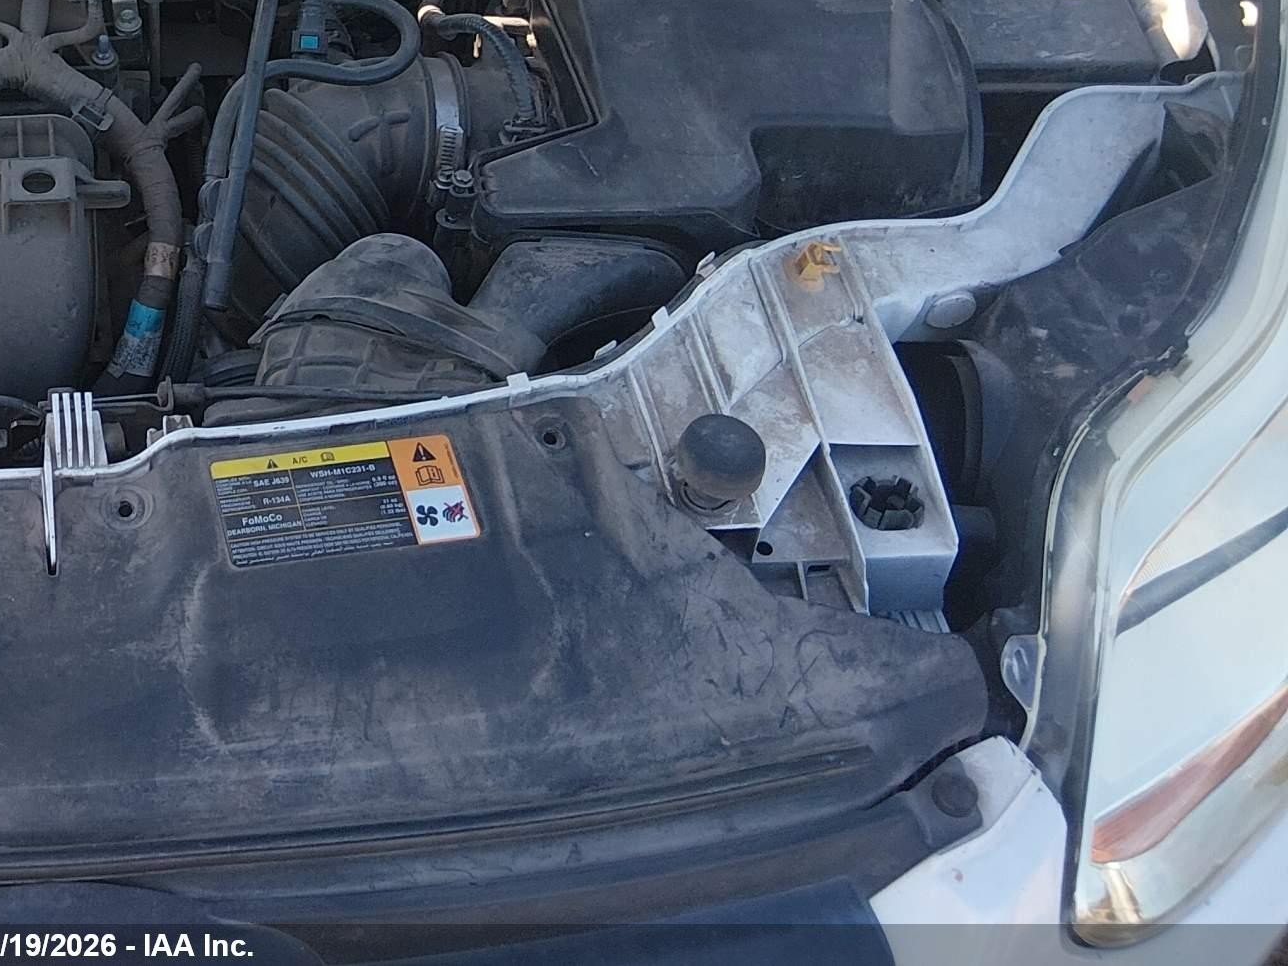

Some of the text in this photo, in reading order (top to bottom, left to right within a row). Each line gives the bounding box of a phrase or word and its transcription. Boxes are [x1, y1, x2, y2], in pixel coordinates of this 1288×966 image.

[292, 456, 308, 465] A/C
[253, 479, 270, 488] SAE
[271, 476, 290, 485] J639
[262, 494, 291, 505] R-134A
[242, 513, 283, 526] FoMoCo
[268, 520, 302, 530] MICHIGAN
